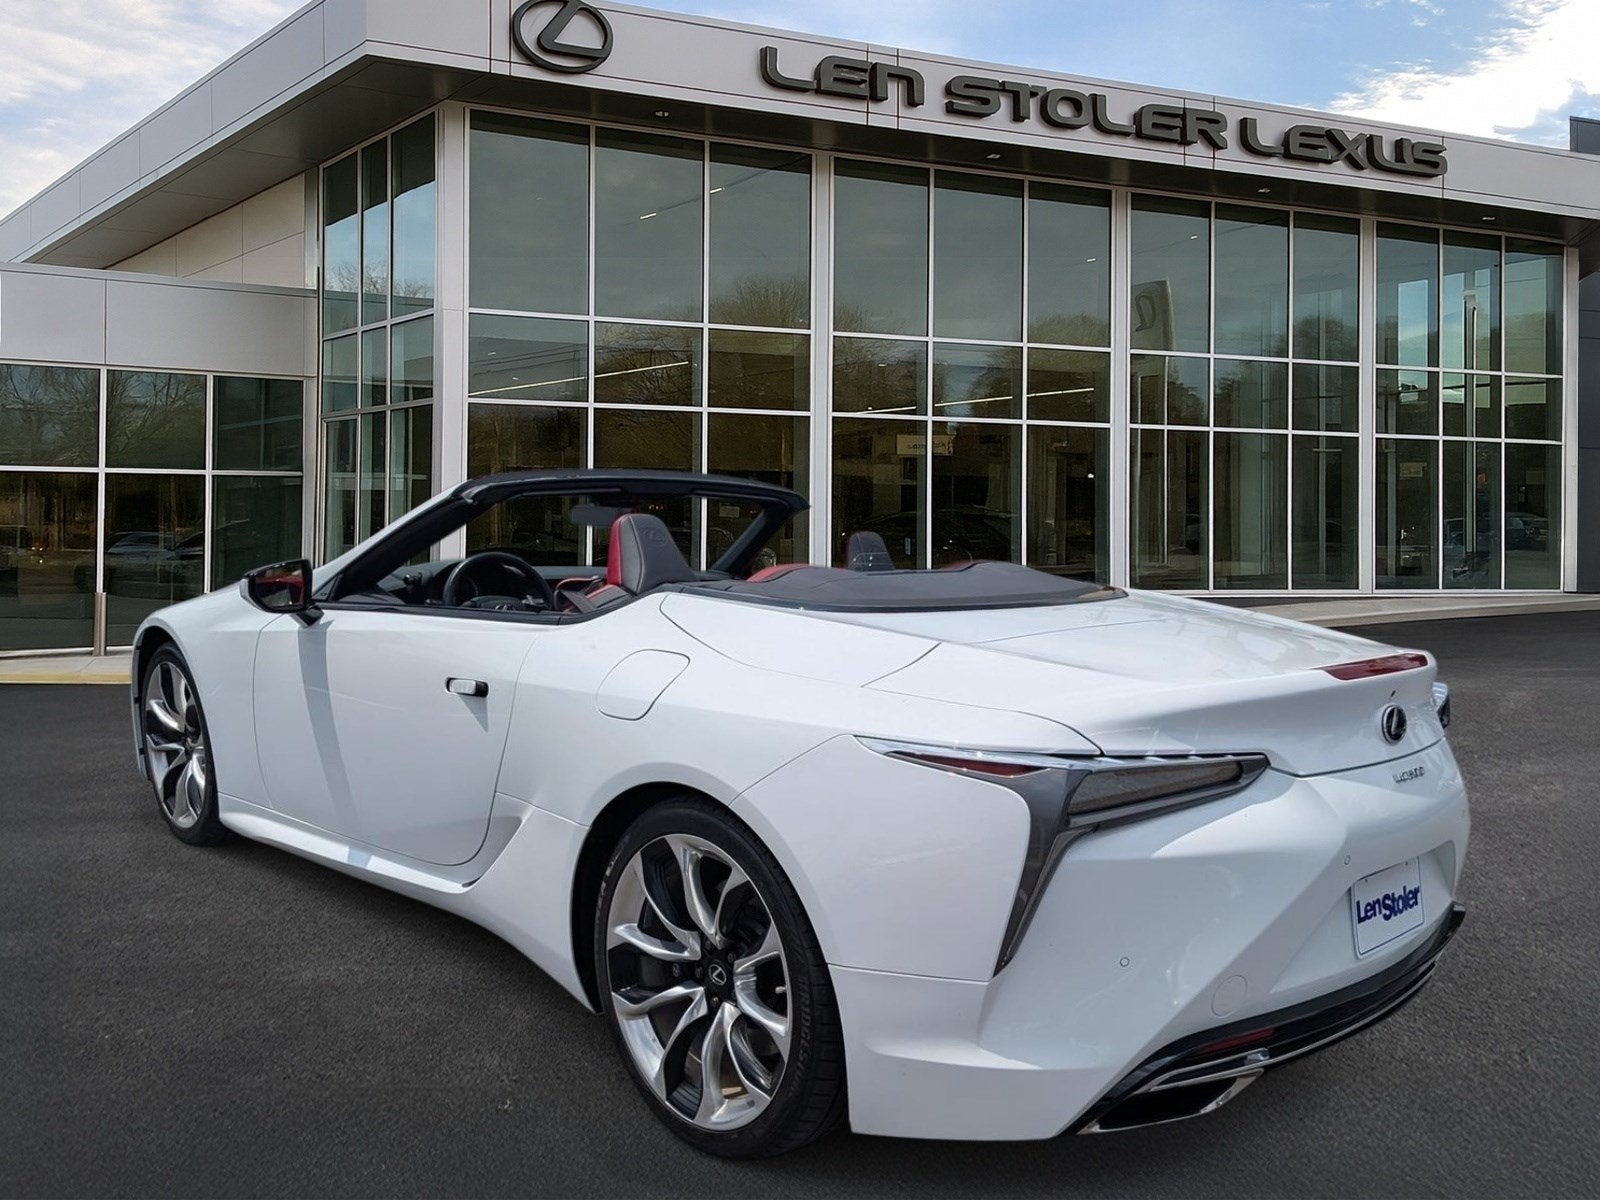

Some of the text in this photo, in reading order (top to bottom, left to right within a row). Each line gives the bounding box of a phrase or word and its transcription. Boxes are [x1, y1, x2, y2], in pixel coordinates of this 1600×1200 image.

[760, 46, 1448, 178] LEN STOLER LEXUS
